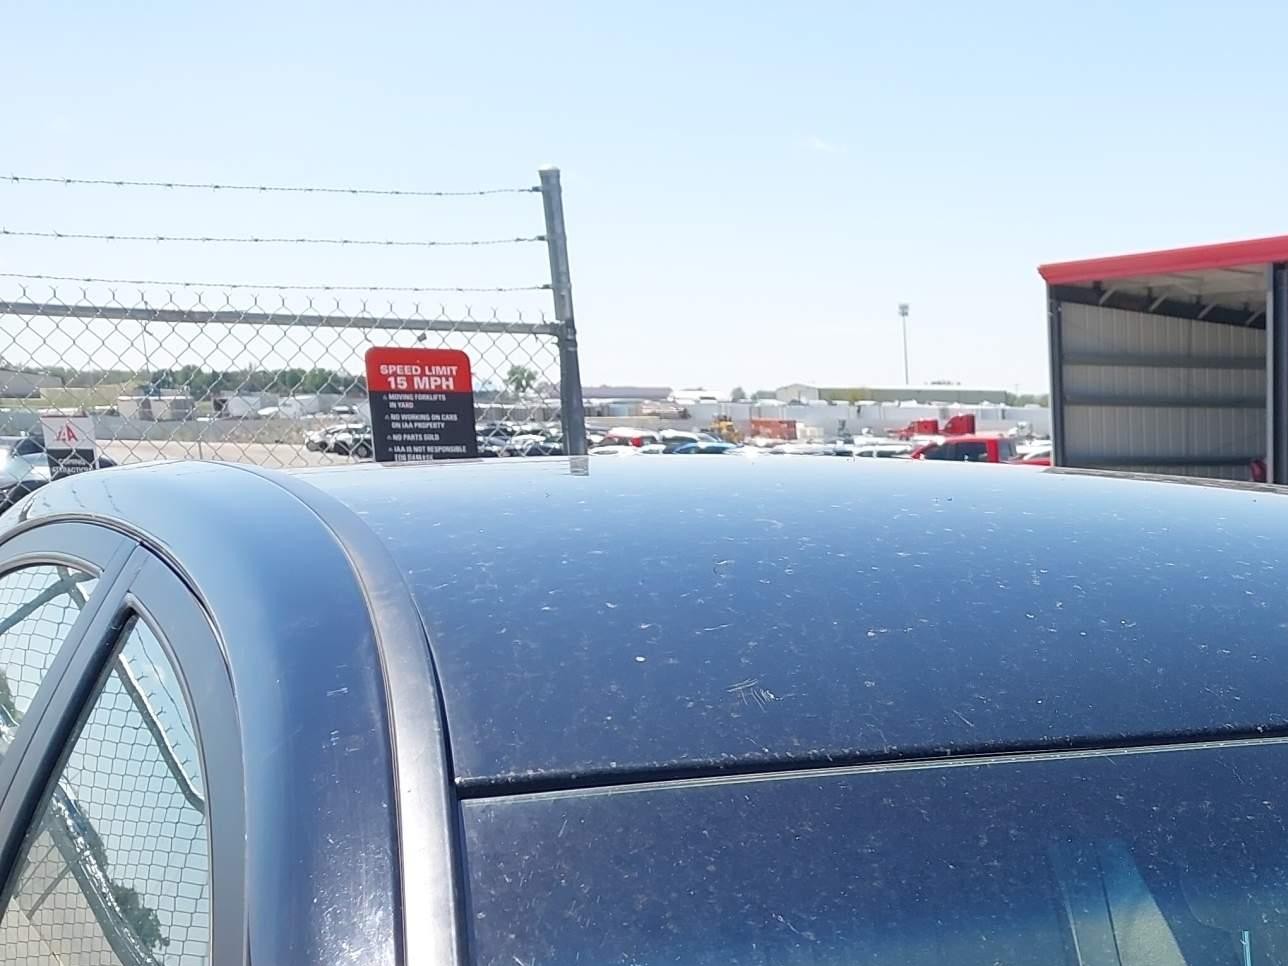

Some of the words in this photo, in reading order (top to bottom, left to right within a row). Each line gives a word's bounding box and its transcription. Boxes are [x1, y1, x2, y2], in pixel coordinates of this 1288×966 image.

[379, 364, 421, 375] SPEED
[425, 366, 458, 376] LIMIT
[387, 376, 408, 389] 15
[413, 376, 454, 390] MPH
[426, 445, 467, 453] RESPONSIBLE
